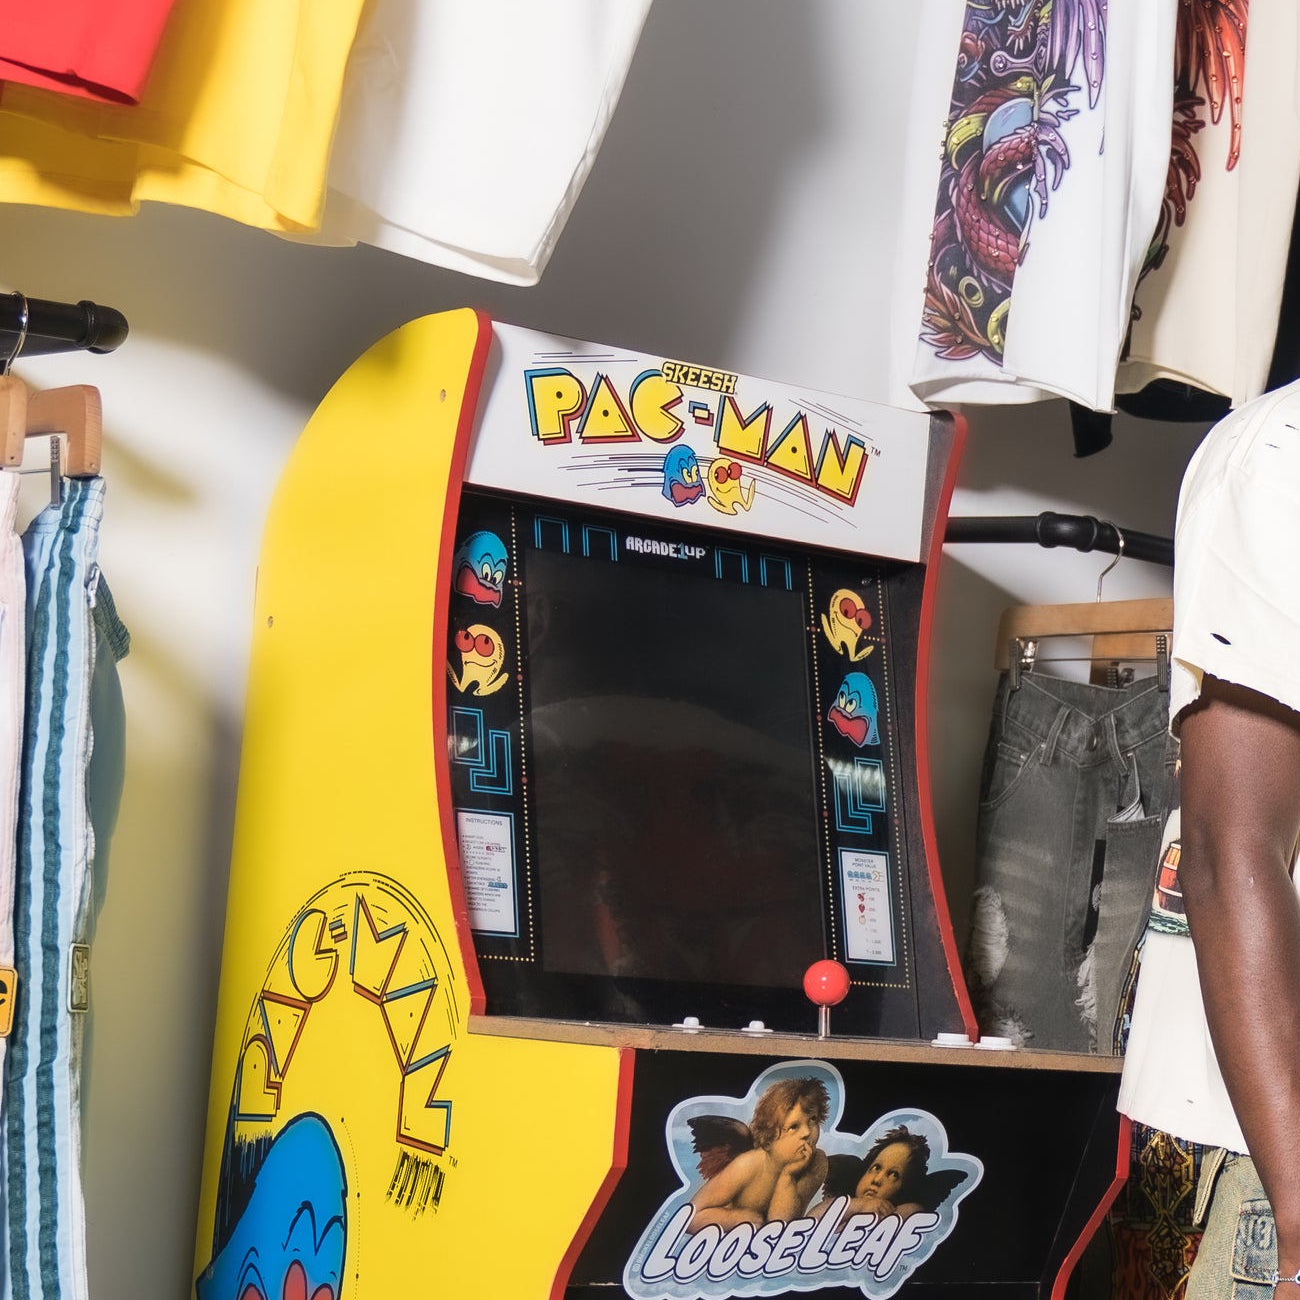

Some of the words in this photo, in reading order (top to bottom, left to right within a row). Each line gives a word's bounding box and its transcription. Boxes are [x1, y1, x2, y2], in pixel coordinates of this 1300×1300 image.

[662, 361, 738, 395] SKEESH
[524, 367, 868, 507] PAC-MAN
[465, 817, 503, 827] INSTRUCTIONS
